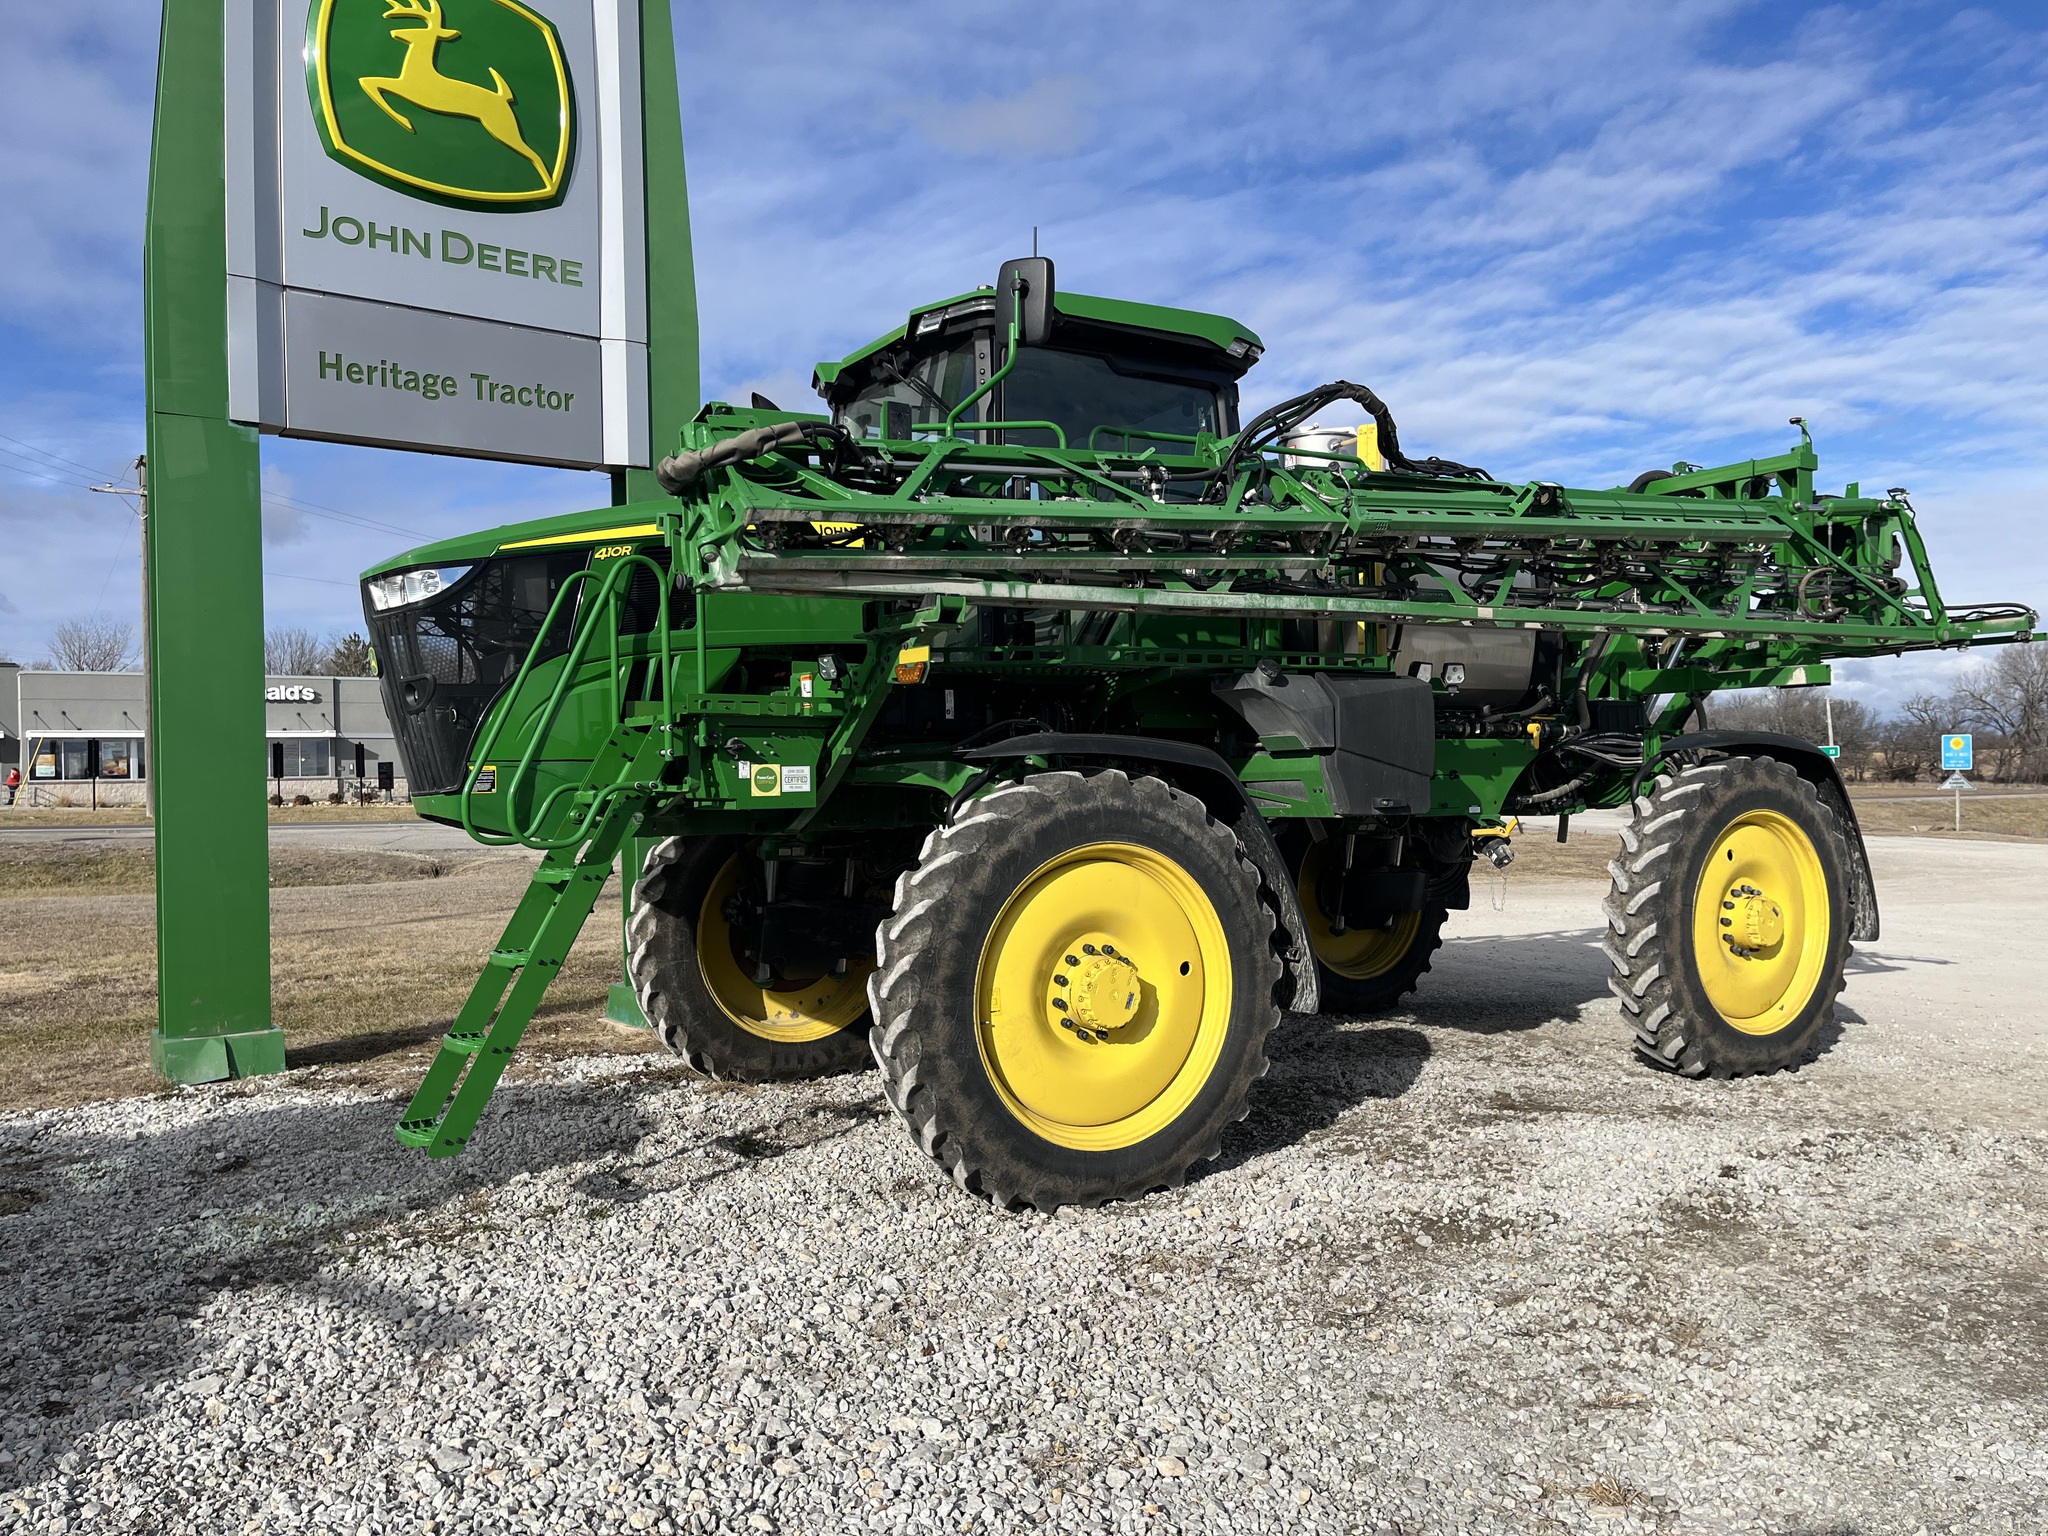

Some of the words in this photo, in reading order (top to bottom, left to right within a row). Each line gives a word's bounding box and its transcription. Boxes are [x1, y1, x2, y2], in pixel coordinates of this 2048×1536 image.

[302, 206, 431, 259] JOHN
[441, 229, 583, 287] DEERE
[318, 351, 458, 400] Heritage
[470, 373, 575, 412] Tractor
[594, 545, 632, 560] 410R
[265, 685, 315, 701] ald's
